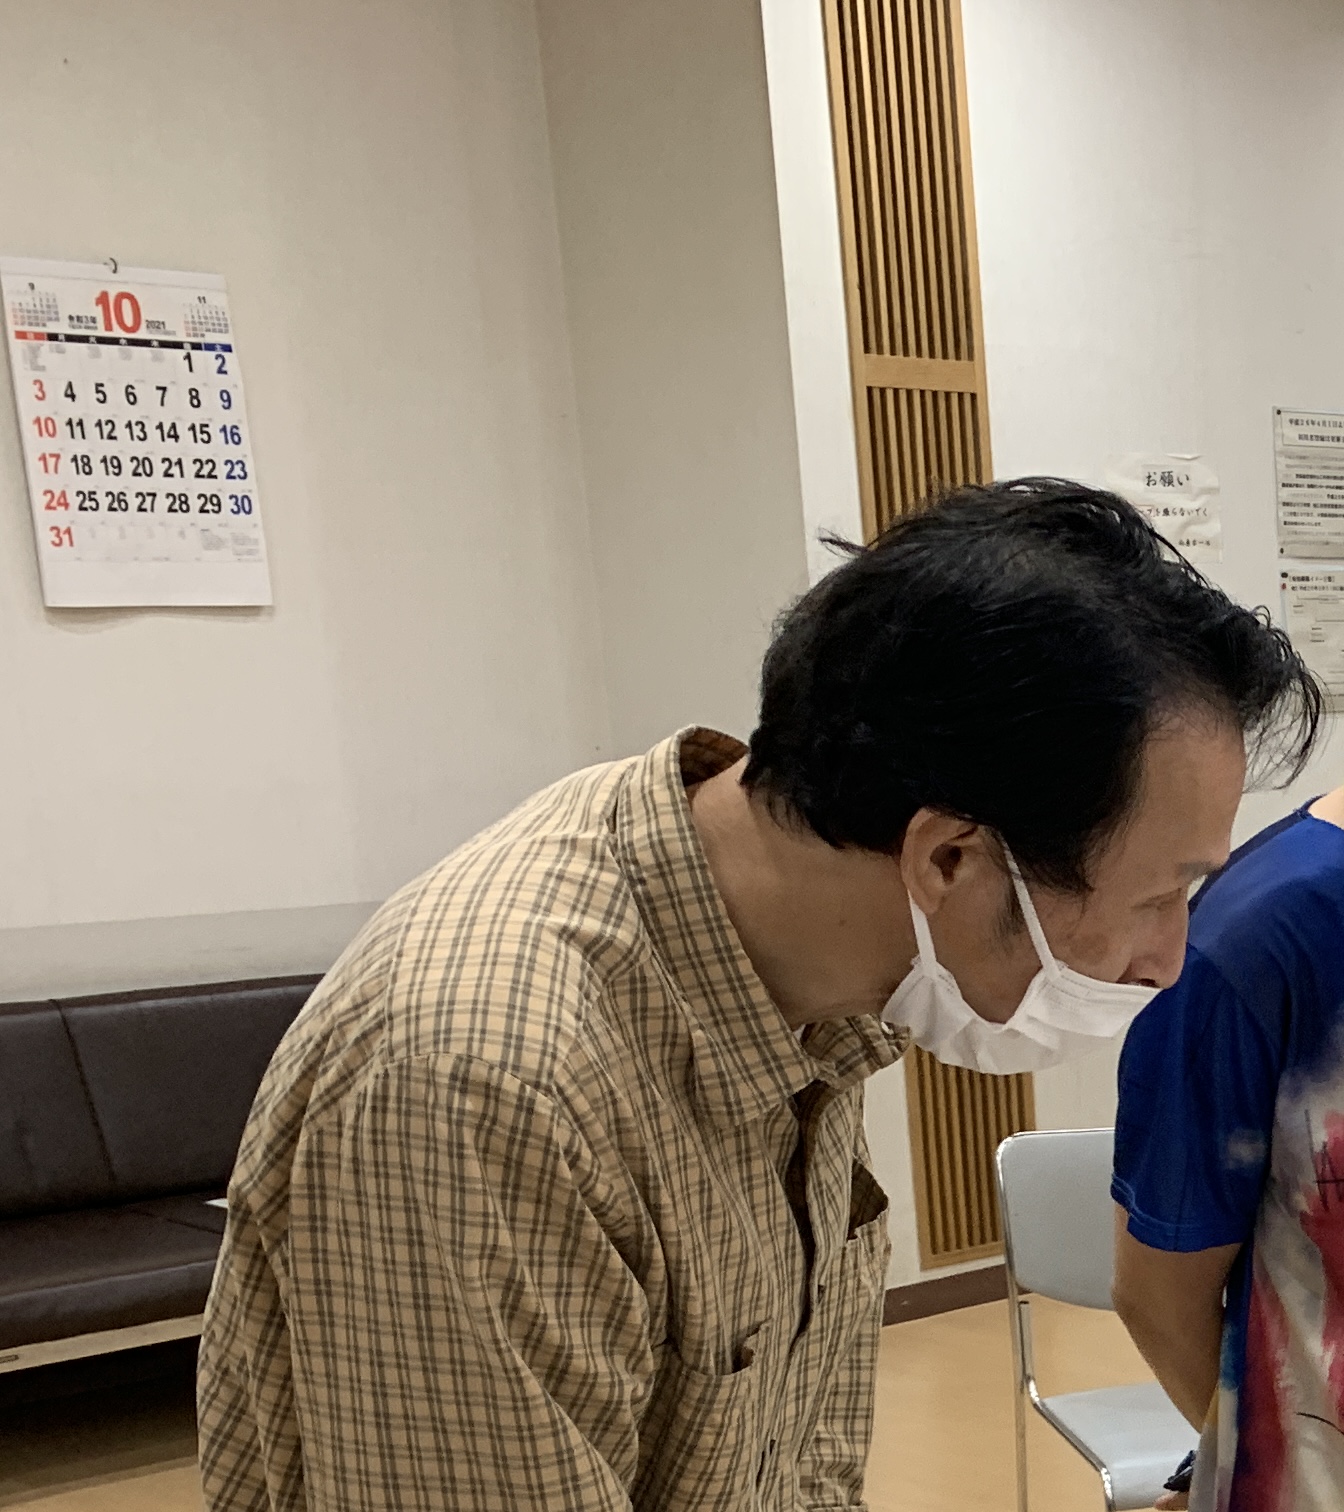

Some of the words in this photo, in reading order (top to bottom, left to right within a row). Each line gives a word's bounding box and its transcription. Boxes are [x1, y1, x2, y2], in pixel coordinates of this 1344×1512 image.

[94, 290, 142, 334] 10
[196, 295, 208, 304] 11
[145, 319, 167, 330] 2021
[182, 352, 194, 374] 1
[214, 353, 228, 376] 2
[32, 379, 47, 402] 3
[63, 380, 77, 403] 4
[94, 382, 108, 405] 5
[124, 383, 138, 406] 6
[155, 385, 168, 408] 7
[187, 387, 202, 409] 8
[219, 389, 232, 411] 9
[32, 415, 57, 439] 10
[64, 417, 87, 441] 11
[94, 418, 118, 441] 12
[124, 419, 148, 442] 13
[154, 421, 180, 444] 14
[187, 422, 212, 445] 15
[219, 424, 242, 446] 16
[38, 452, 61, 475] 17
[70, 453, 93, 476] 18
[99, 454, 123, 477] 19
[129, 455, 154, 478] 20
[160, 456, 185, 479] 21
[192, 457, 219, 480] 22
[223, 459, 248, 481] 23
[1145, 470, 1191, 488] お願い
[42, 489, 70, 511] 24
[75, 489, 100, 512] 25
[104, 490, 129, 513] 26
[134, 491, 158, 513] 27
[164, 492, 191, 514] 28
[196, 492, 222, 515] 29
[228, 493, 253, 516] 30
[49, 525, 74, 548] 31
